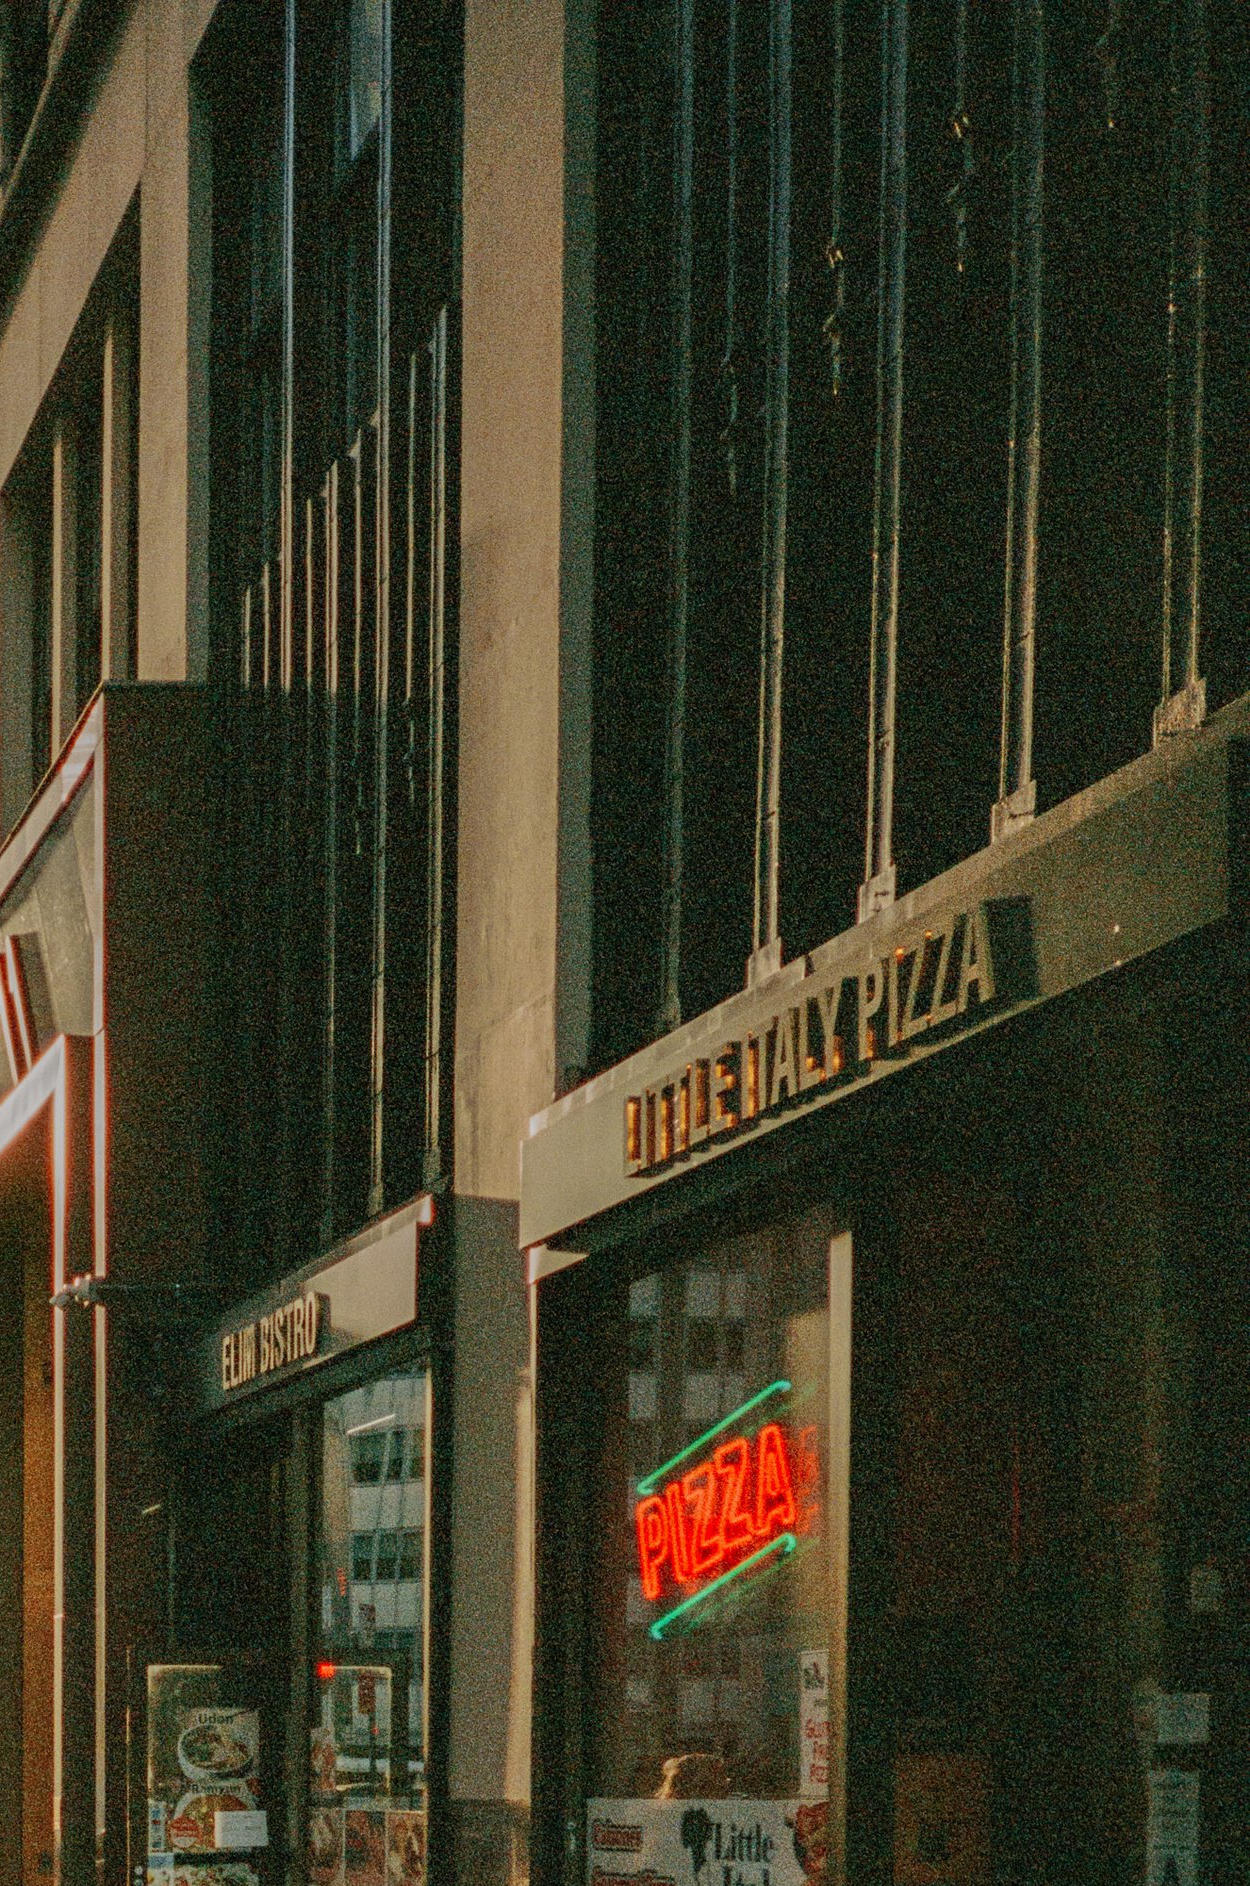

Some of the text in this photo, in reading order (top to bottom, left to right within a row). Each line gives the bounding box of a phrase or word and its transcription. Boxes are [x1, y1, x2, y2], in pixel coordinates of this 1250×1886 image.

[624, 904, 996, 1174] LITTLE ITALY PIZZA
[259, 1291, 317, 1374] BISTRO
[634, 1422, 797, 1600] PIZZA
[708, 1822, 774, 1863] Little
